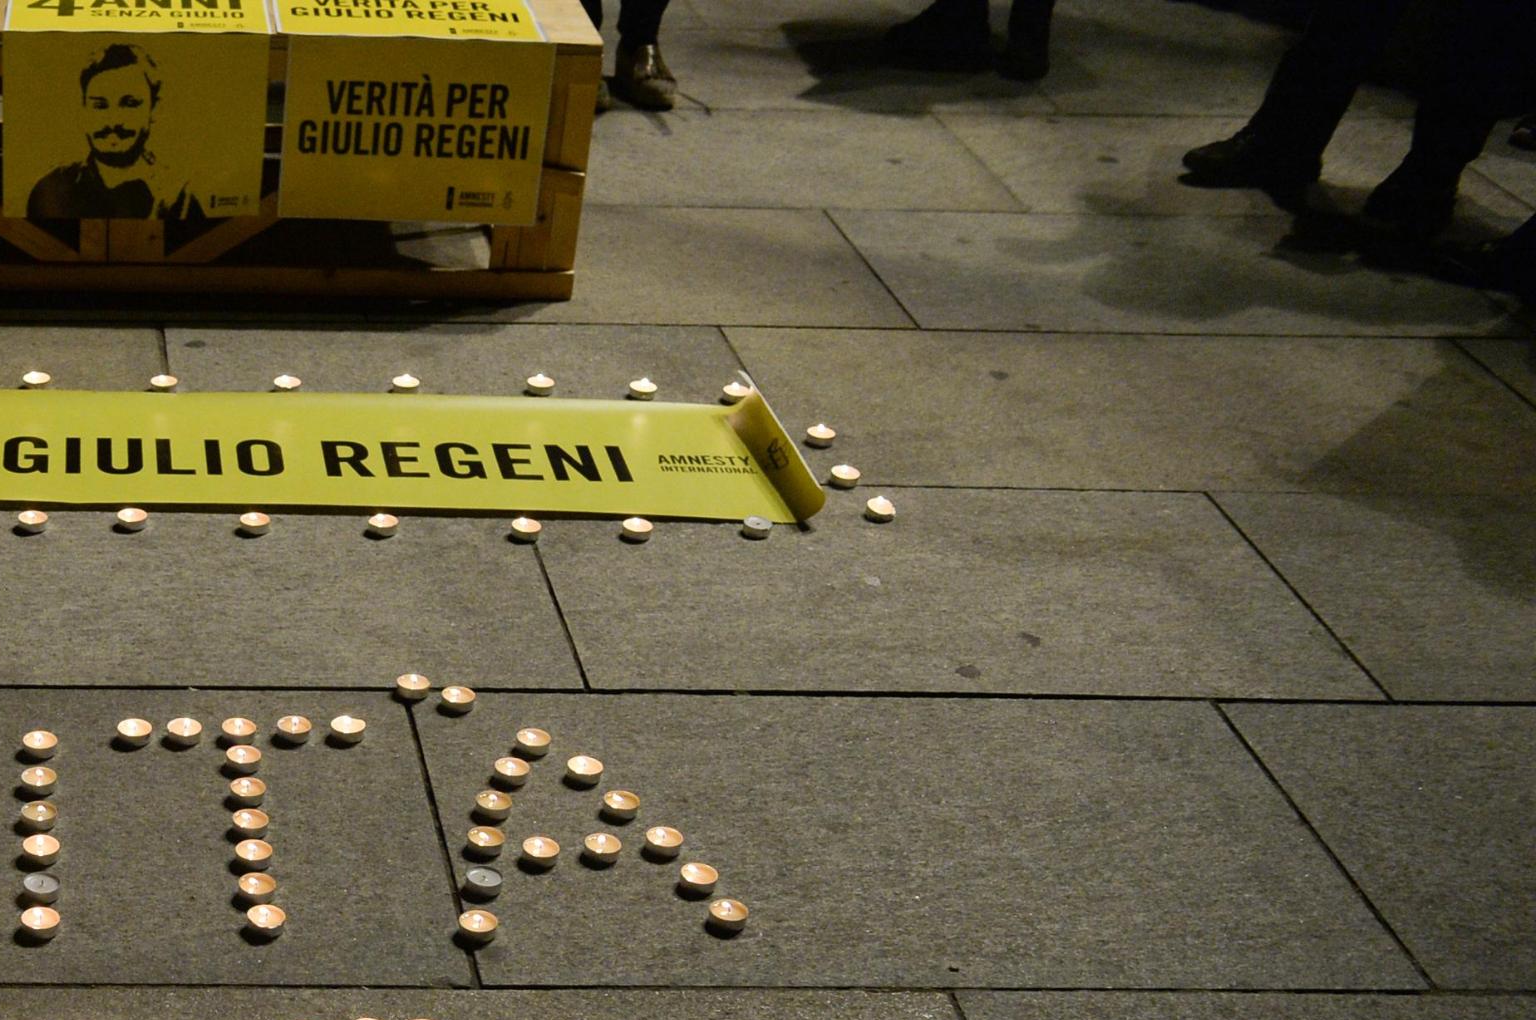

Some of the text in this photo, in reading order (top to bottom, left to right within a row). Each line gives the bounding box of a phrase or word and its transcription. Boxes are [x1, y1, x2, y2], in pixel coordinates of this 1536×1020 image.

[27, 0, 242, 17] 4 ANNI
[90, 9, 245, 19] SENZA GIULIO
[291, 6, 520, 23] GIULIO REGENI
[429, 1, 489, 12] PER
[326, 74, 510, 119] VERITÀ PER
[298, 119, 530, 161] GIULIO REGENI
[2, 436, 285, 477] GIULIO
[320, 440, 634, 482] REGENI
[658, 454, 750, 467] AMNESTY
[660, 465, 759, 475] INTERNATIONAL
